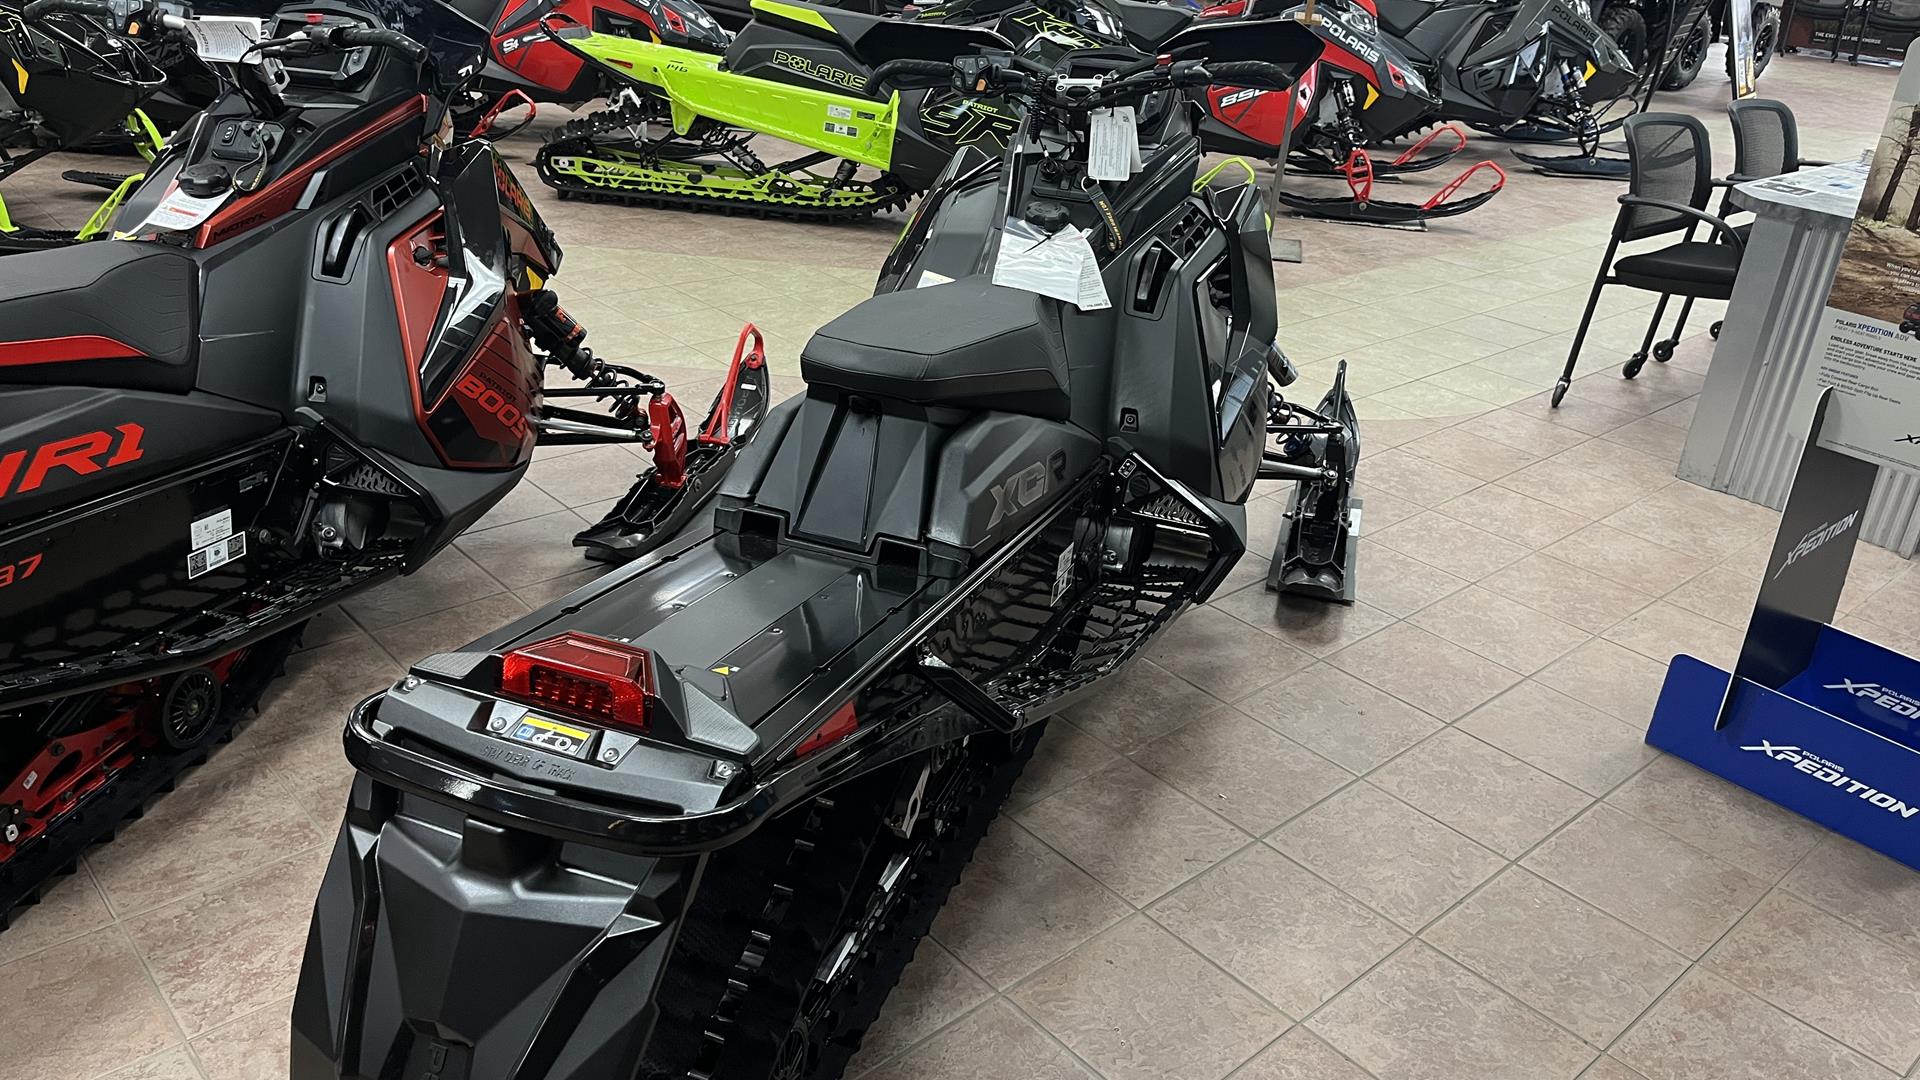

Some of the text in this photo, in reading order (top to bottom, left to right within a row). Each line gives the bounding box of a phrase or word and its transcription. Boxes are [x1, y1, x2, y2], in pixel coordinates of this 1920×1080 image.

[1321, 17, 1380, 63] POLARIS
[1551, 4, 1597, 40] POLARIS
[773, 50, 869, 91] POLARIS
[962, 99, 999, 114] PATRIOT
[1830, 335, 1917, 362] ENDLESS ADVENTURE STARTS HERE
[1857, 322, 1893, 338] XPEDITION
[1894, 332, 1909, 342] ADV
[986, 448, 1066, 531] XCR
[1774, 510, 1858, 580] XPEDITION
[547, 763, 578, 782] TRACK
[1740, 739, 1919, 818] XPEDITION
[1802, 750, 1845, 773] POLARIS
